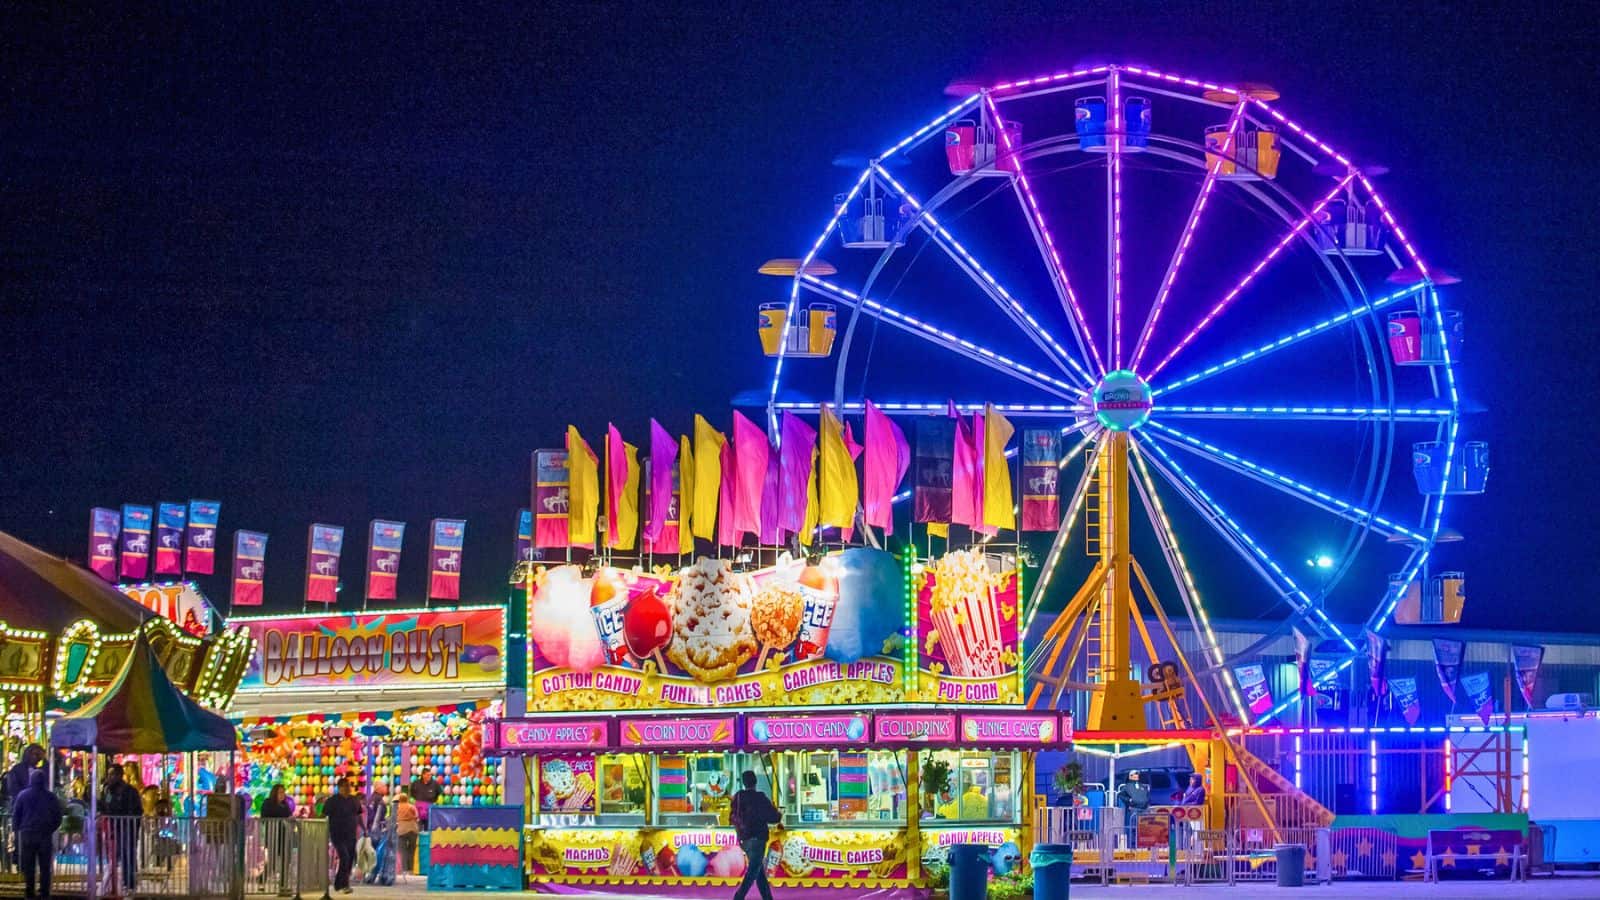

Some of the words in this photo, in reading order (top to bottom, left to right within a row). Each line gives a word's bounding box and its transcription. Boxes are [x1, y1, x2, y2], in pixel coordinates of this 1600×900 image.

[264, 629, 386, 686] BALLOON
[390, 623, 464, 679] BUST
[542, 671, 593, 694] COTTON
[595, 672, 642, 696] CANDY
[783, 662, 843, 691] CARAMEL
[847, 661, 895, 684] APPLES
[660, 683, 714, 705] FUNNEL
[716, 681, 762, 703] CAKES
[938, 680, 963, 700] POP
[964, 681, 999, 702] CORN
[520, 726, 553, 742] CANDY
[555, 725, 589, 741] APPLES
[643, 725, 676, 742] CORN
[679, 724, 712, 740] DOGS
[766, 721, 813, 738] COTTON
[815, 721, 851, 737] CANDY
[879, 719, 914, 736] COLD
[916, 719, 951, 736] DRINKS
[977, 720, 1010, 737] FUNNEL
[674, 832, 711, 848] COTTON
[938, 831, 969, 846] CANDY
[971, 831, 1005, 844] APPLES
[802, 846, 843, 864] FUNNEL
[847, 848, 883, 864] CAKES
